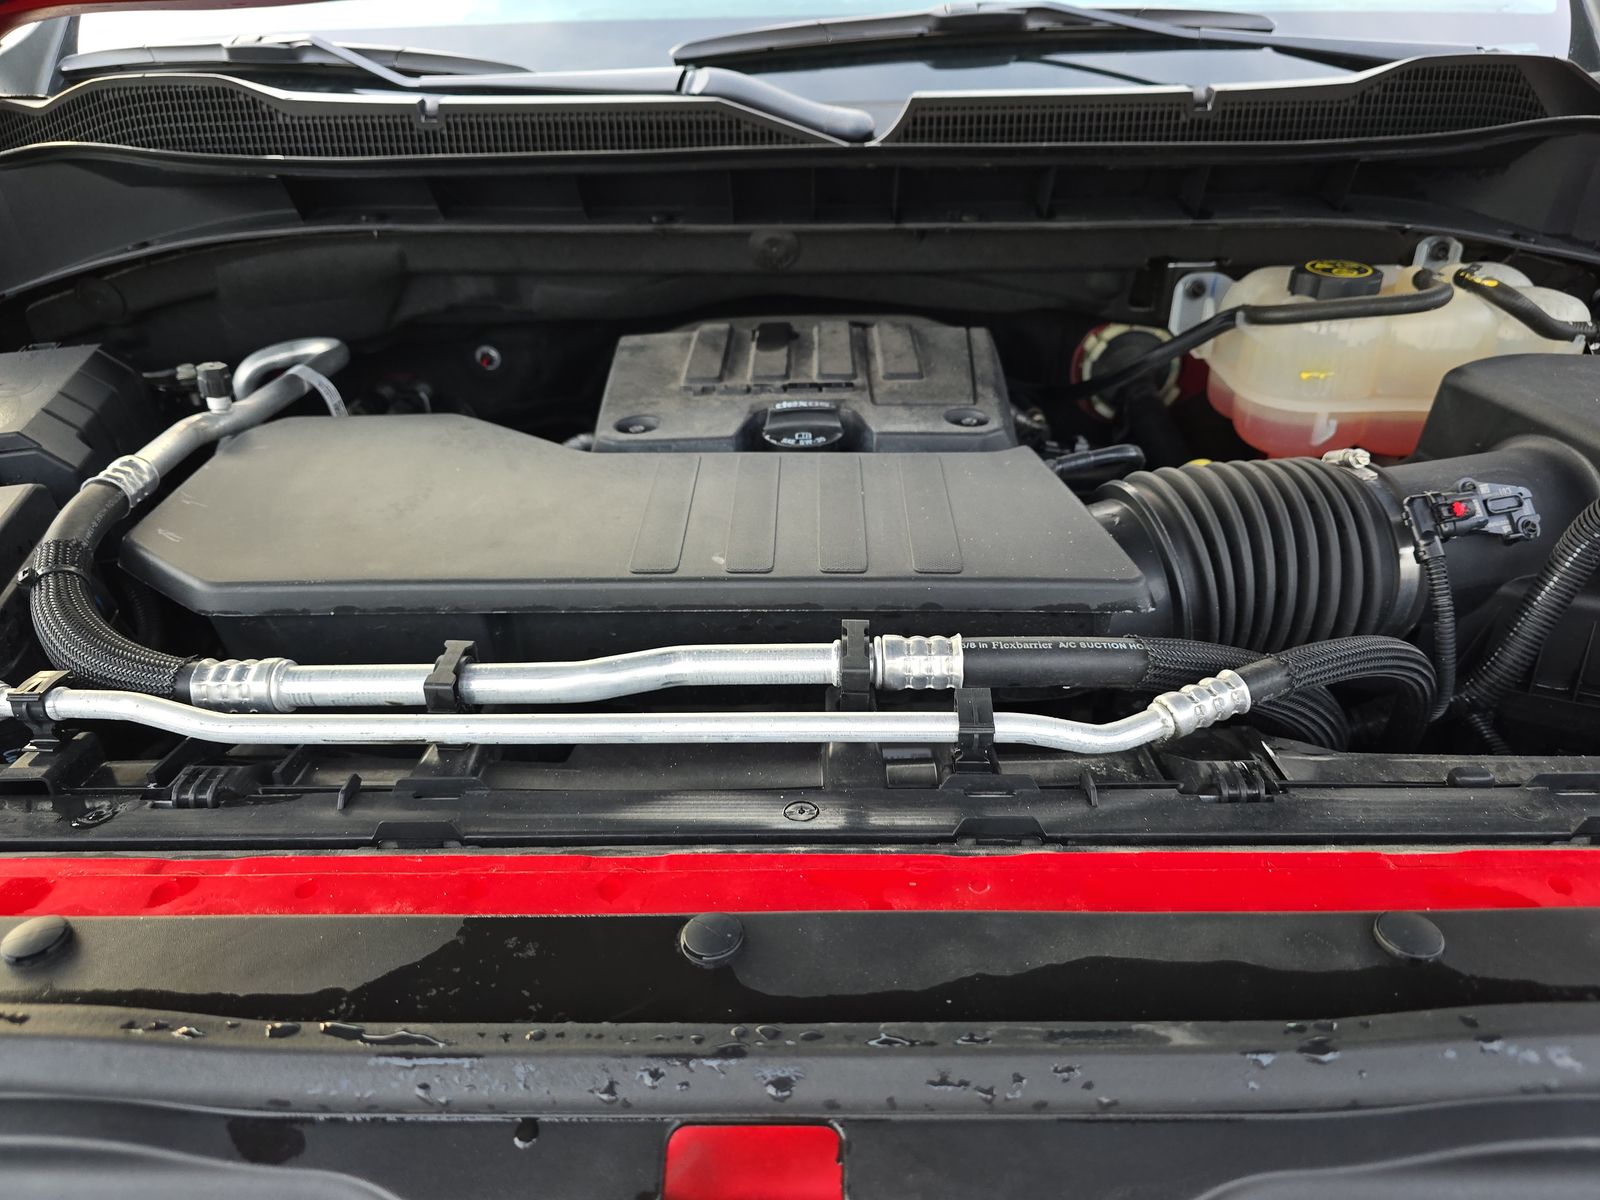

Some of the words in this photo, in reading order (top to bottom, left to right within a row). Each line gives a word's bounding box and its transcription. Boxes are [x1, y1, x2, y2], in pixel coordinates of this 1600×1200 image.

[991, 640, 1053, 650] Flexbarrier
[1059, 641, 1077, 649] A/C
[1079, 641, 1127, 650] SUCTION
